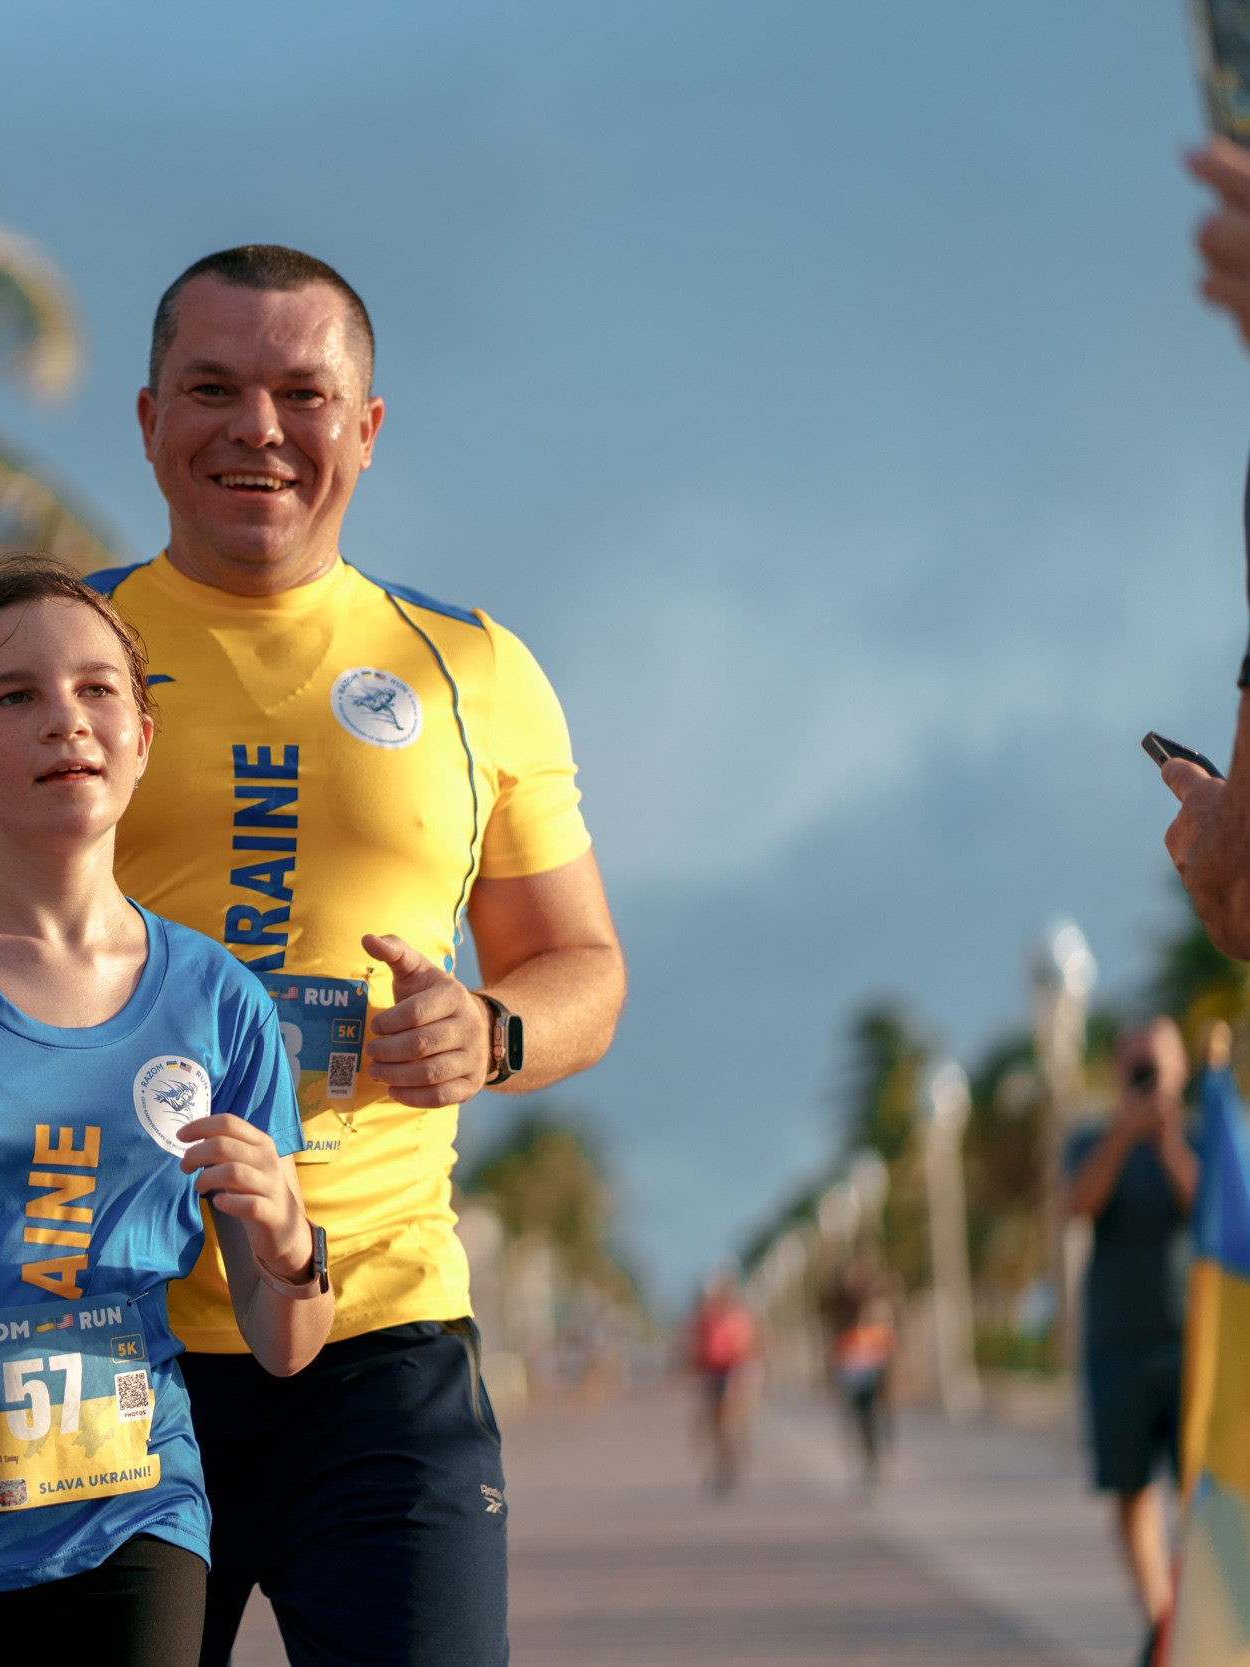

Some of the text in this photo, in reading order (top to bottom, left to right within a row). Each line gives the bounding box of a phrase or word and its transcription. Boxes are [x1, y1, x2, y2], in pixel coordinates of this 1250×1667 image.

[304, 987, 349, 1007] RUN
[337, 1025, 355, 1039] 5K
[140, 1063, 208, 1090] RAZOM RUN
[79, 1306, 123, 1330] RUN
[117, 1341, 138, 1357] 5K
[2, 1352, 83, 1441] 57
[124, 1410, 147, 1418] PHOTOS
[39, 1465, 152, 1494] SLAVA UKRAINI!
